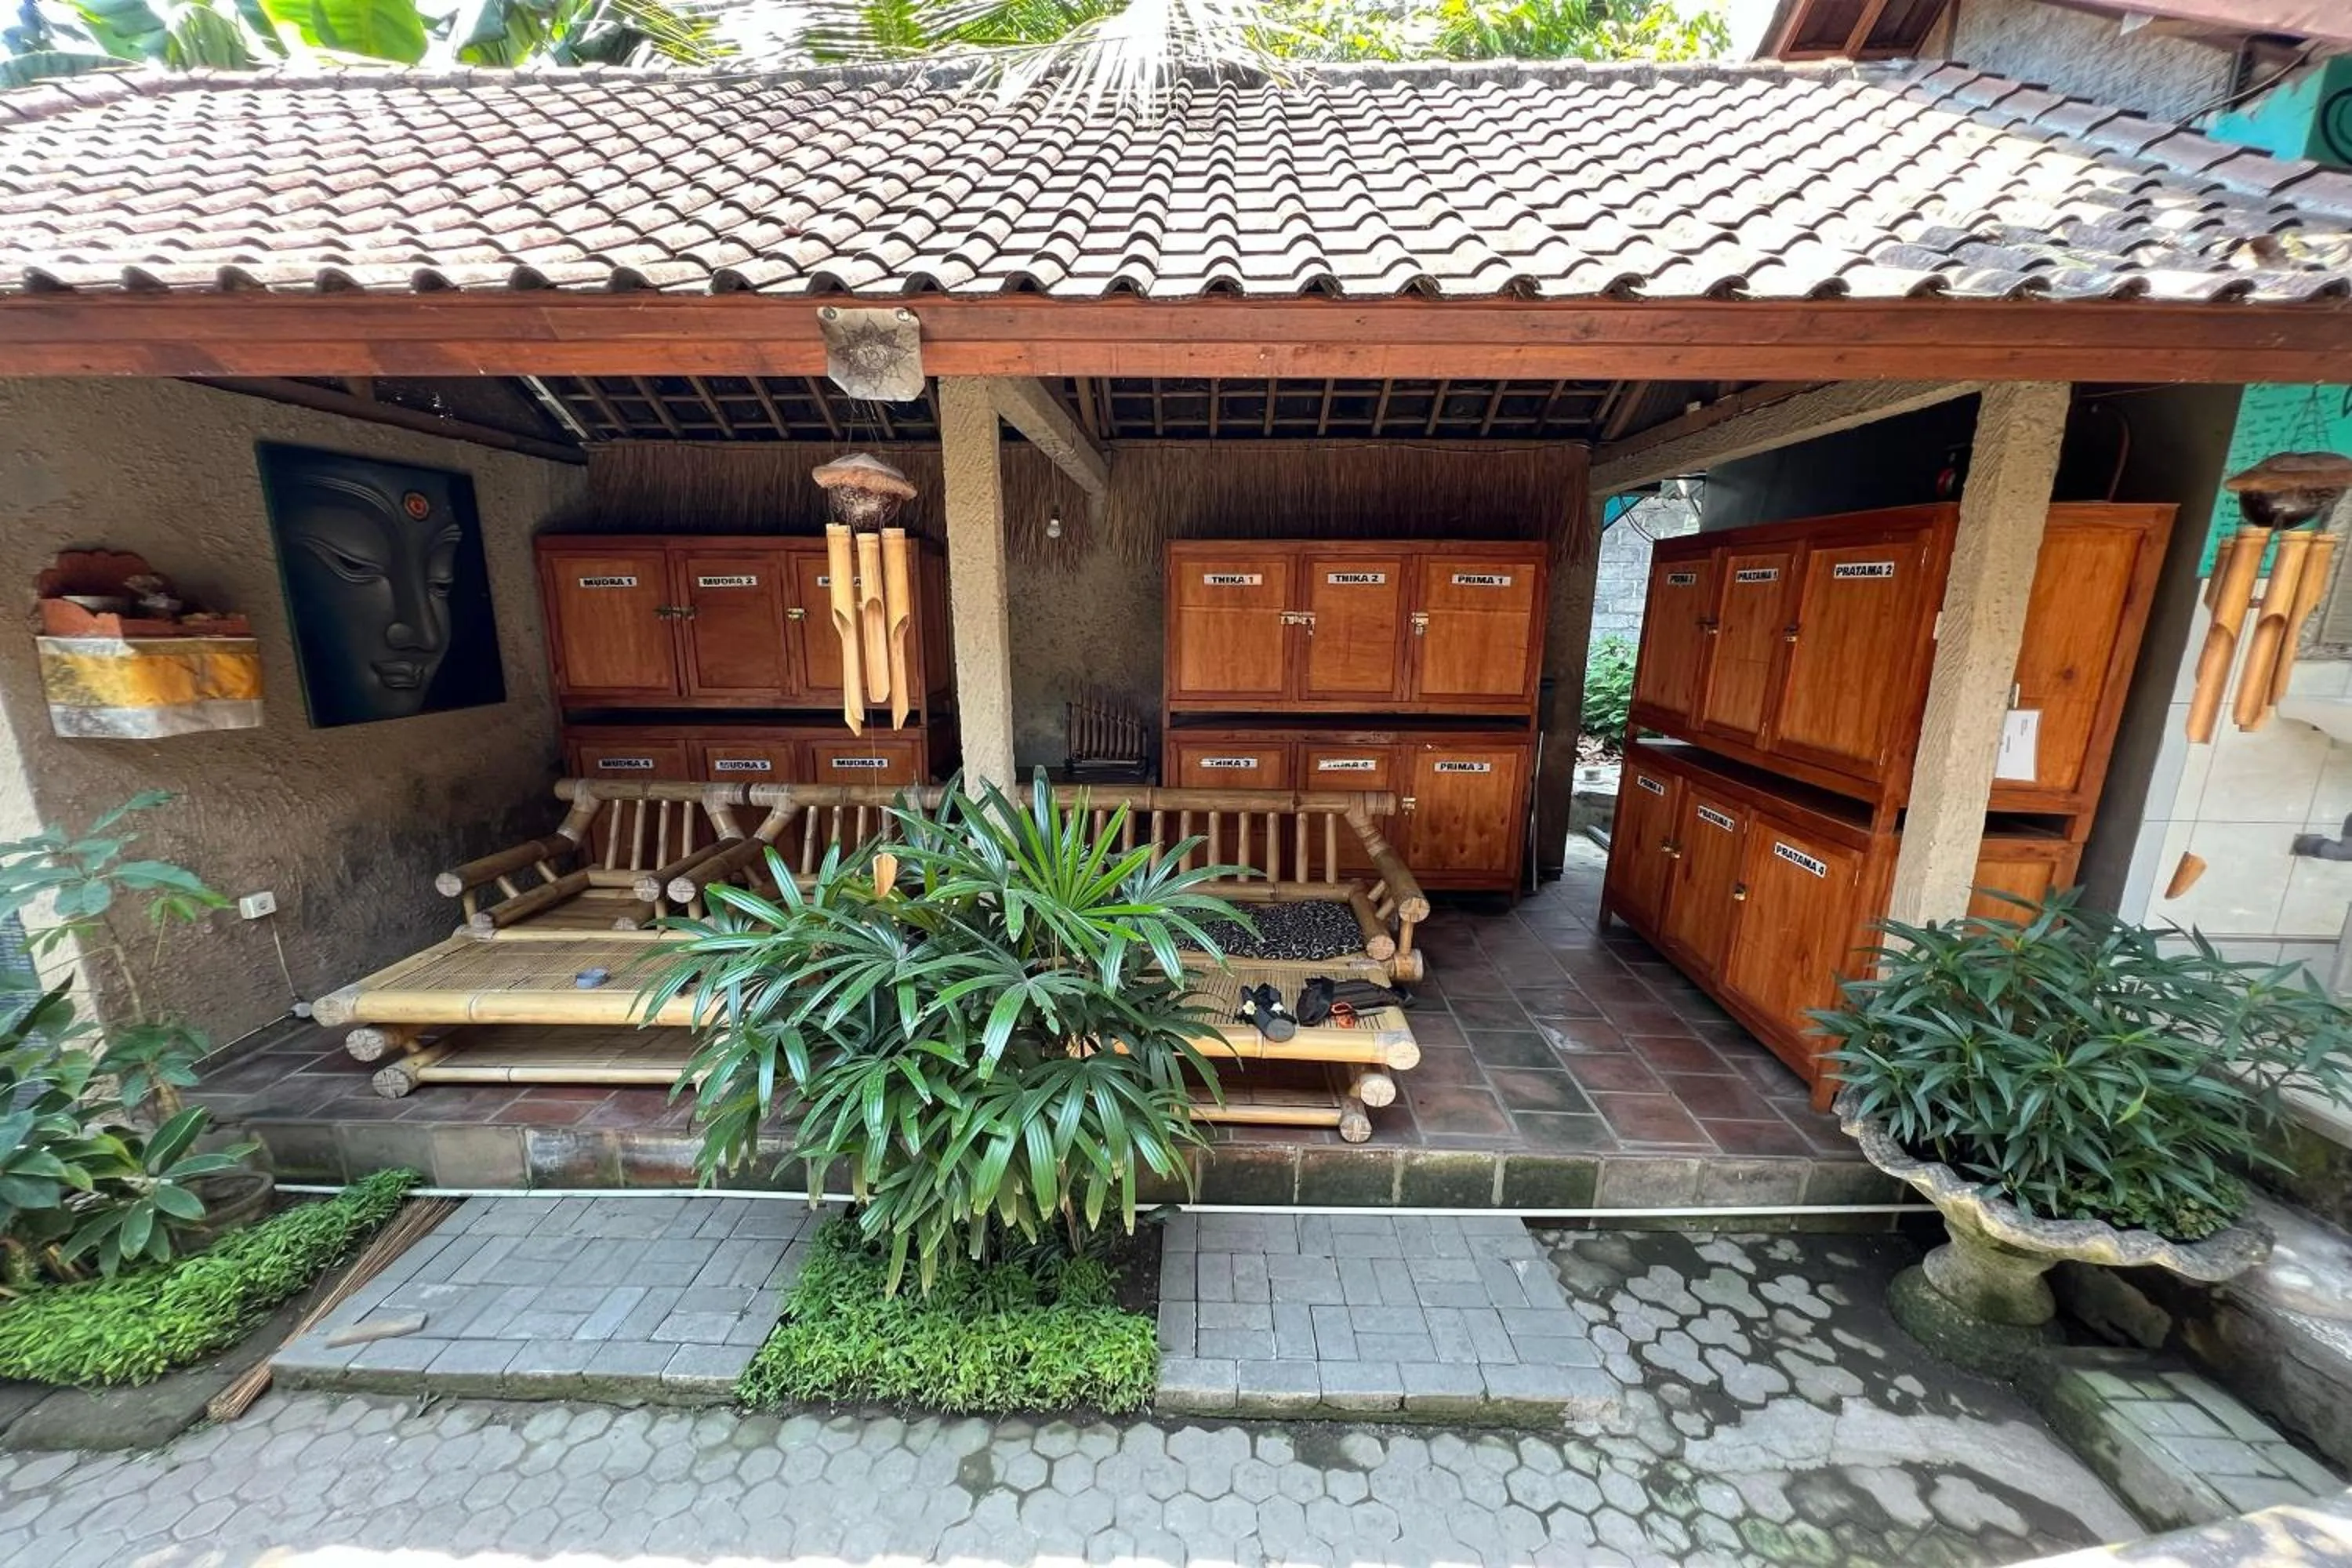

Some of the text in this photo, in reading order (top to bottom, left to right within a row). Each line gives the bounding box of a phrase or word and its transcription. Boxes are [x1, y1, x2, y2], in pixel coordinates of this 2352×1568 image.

[1835, 564, 1892, 575] PRATAMA 2
[1776, 845, 1824, 875] PRATAMA 4
